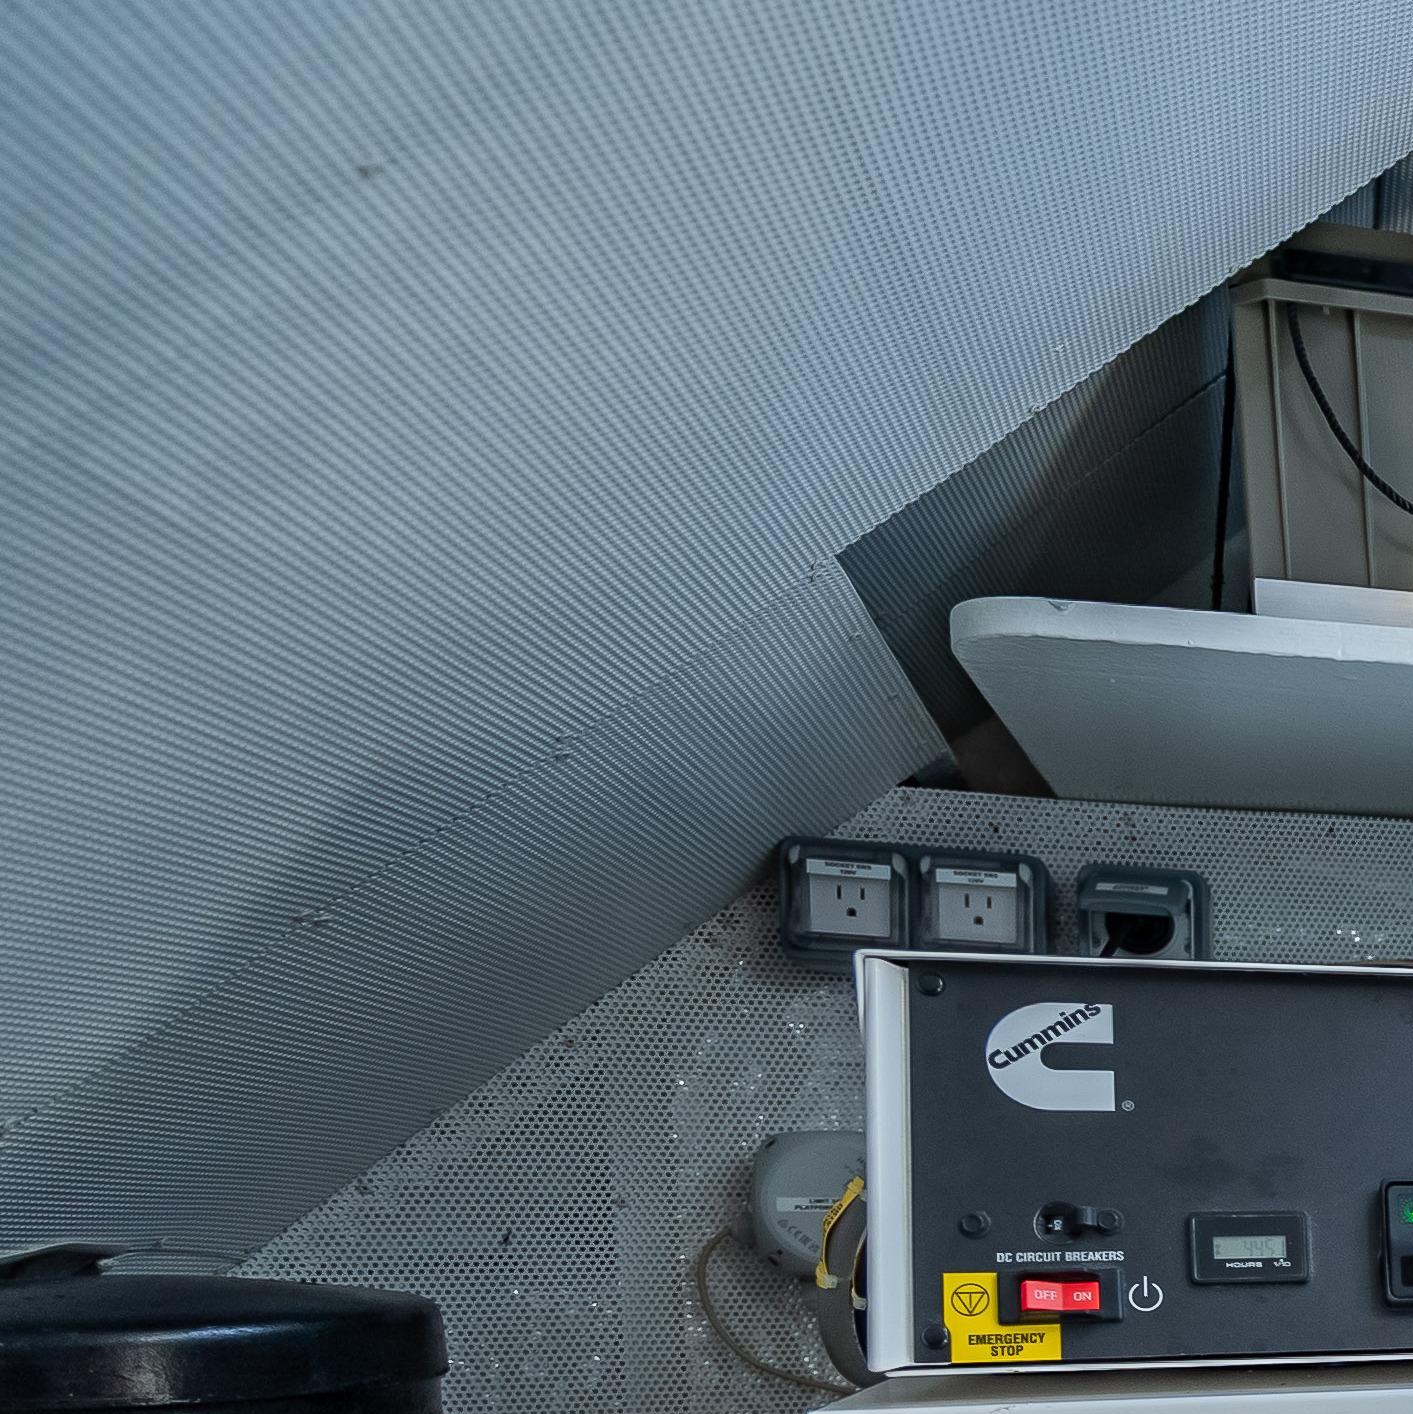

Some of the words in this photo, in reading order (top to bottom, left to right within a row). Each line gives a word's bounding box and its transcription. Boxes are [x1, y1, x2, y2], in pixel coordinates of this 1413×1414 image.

[988, 1003, 1102, 1070] Cummins
[996, 1252, 1012, 1262] DC
[1015, 1251, 1061, 1262] CIRCUIT
[1064, 1250, 1124, 1261] BREAKERS
[1033, 1289, 1057, 1300] OFF
[1073, 1291, 1091, 1301] ON
[967, 1332, 1045, 1345] EMERGENCY
[990, 1344, 1023, 1356] STOP
